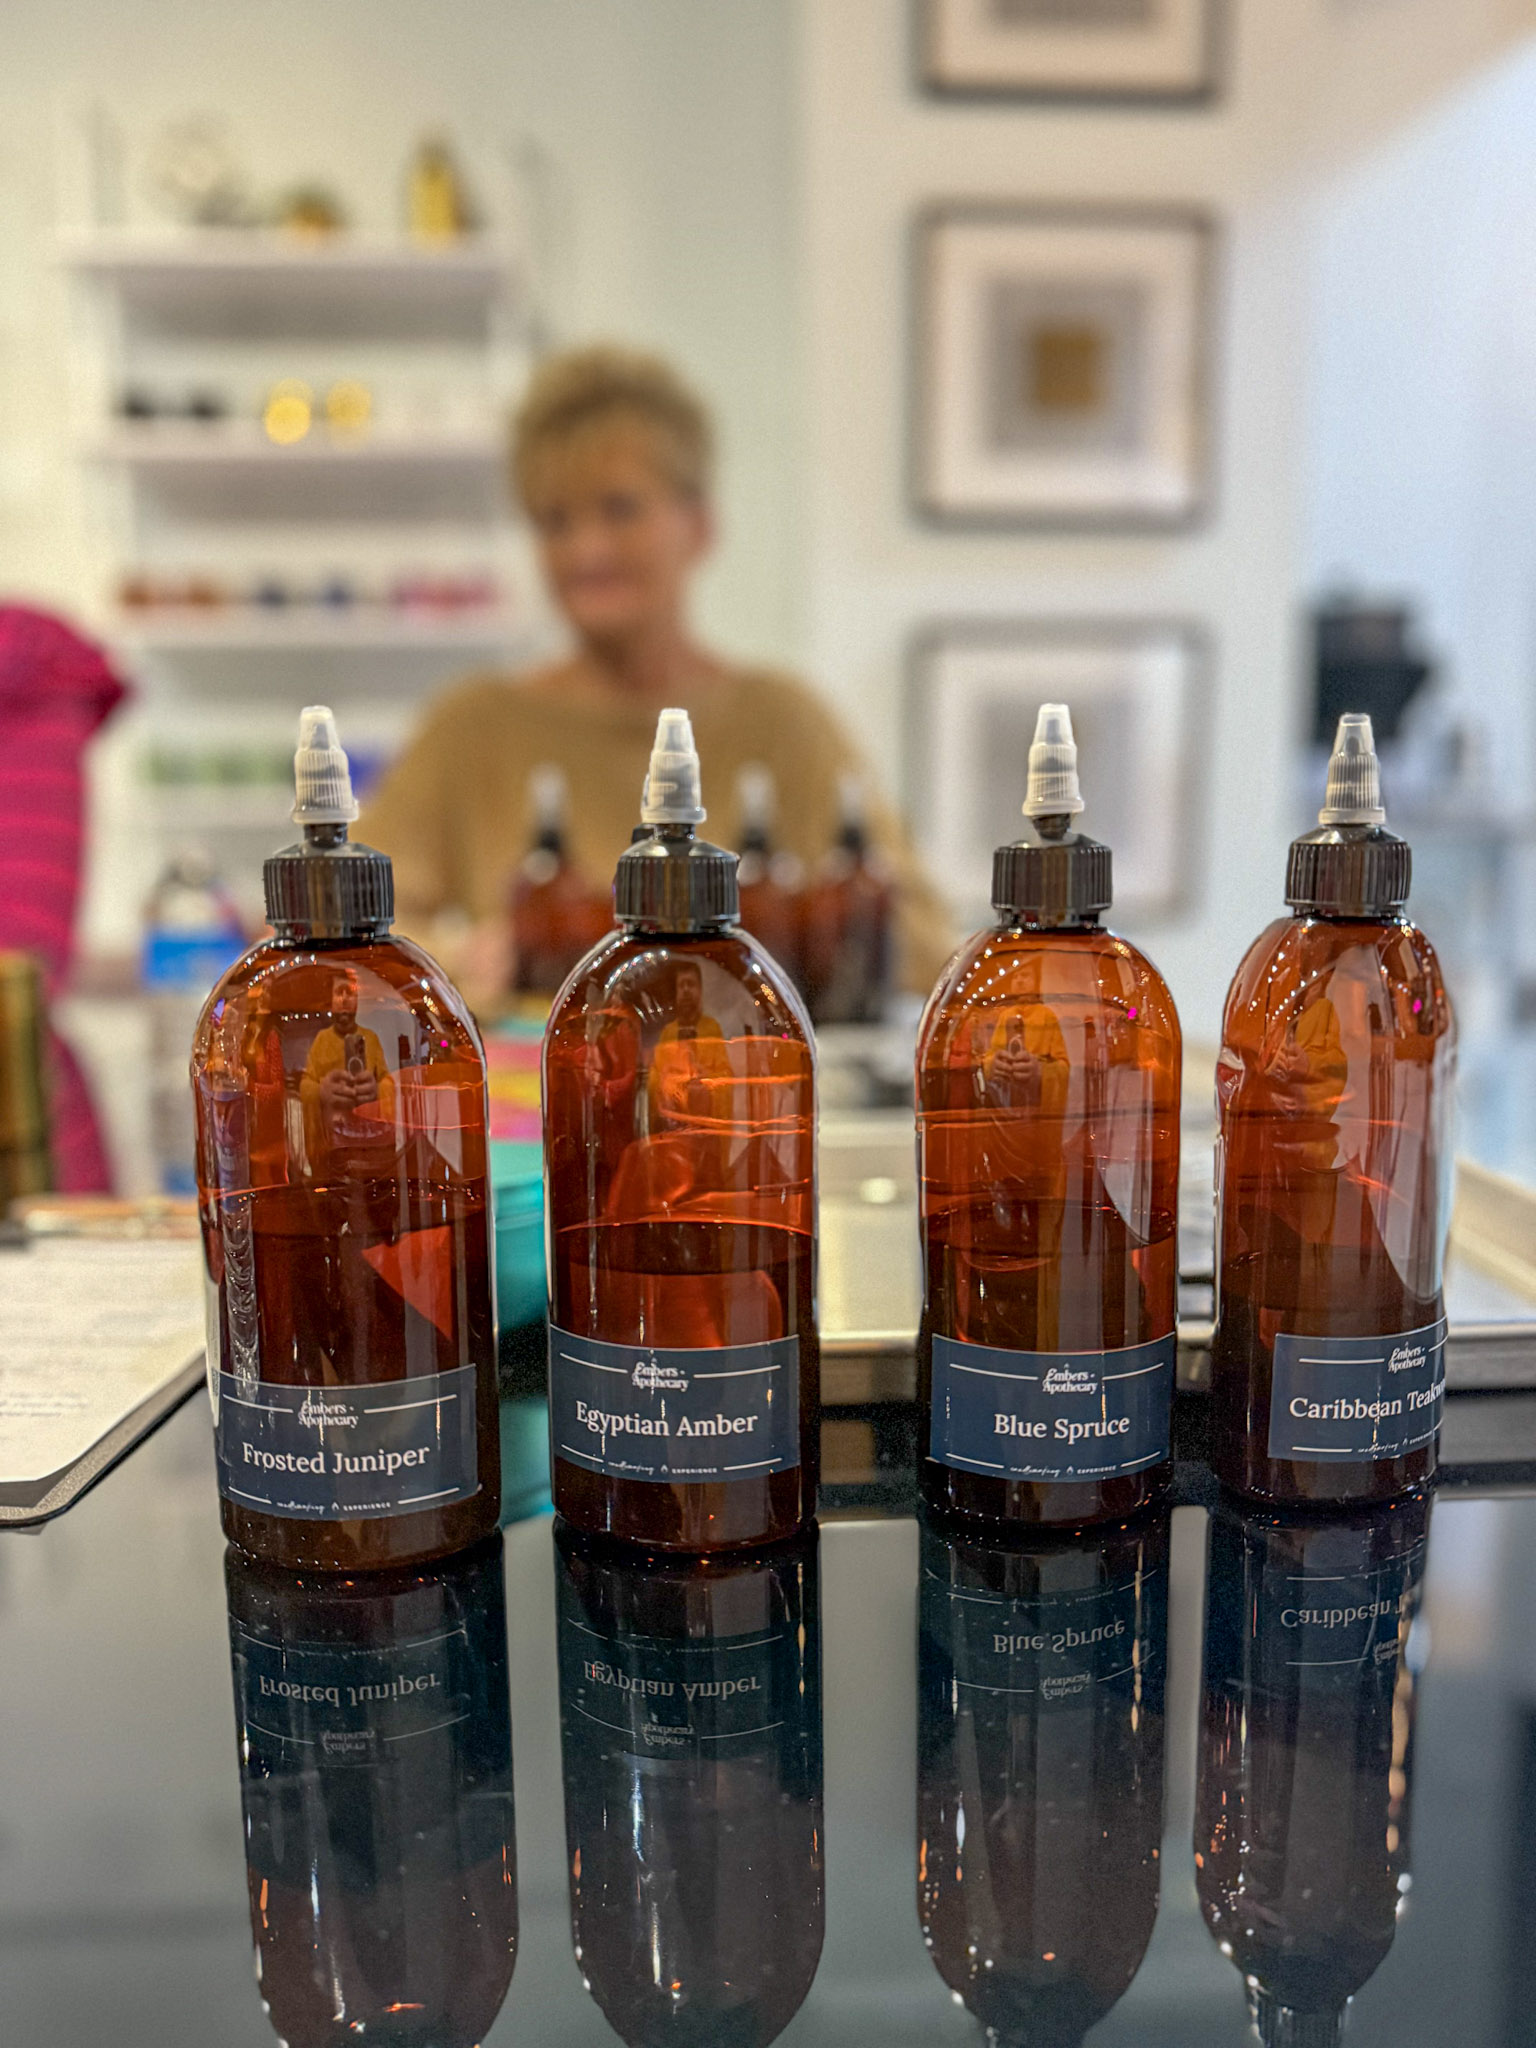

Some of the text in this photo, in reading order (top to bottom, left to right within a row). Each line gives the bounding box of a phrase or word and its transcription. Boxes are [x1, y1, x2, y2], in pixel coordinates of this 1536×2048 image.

[1391, 1346, 1422, 1361] Embers
[635, 1361, 679, 1377] Embers
[1388, 1355, 1427, 1374] Apothecary
[632, 1374, 689, 1392] Apothecary
[1045, 1368, 1089, 1382] Embers
[1042, 1380, 1098, 1395] Apothecary
[301, 1401, 347, 1416] Embers
[1289, 1397, 1402, 1420] Caribbean
[298, 1411, 359, 1428] Apothecary
[576, 1400, 759, 1437] Egyptian Amber
[994, 1413, 1131, 1445] Blue Spruce
[242, 1441, 431, 1476] Frosted Juniper
